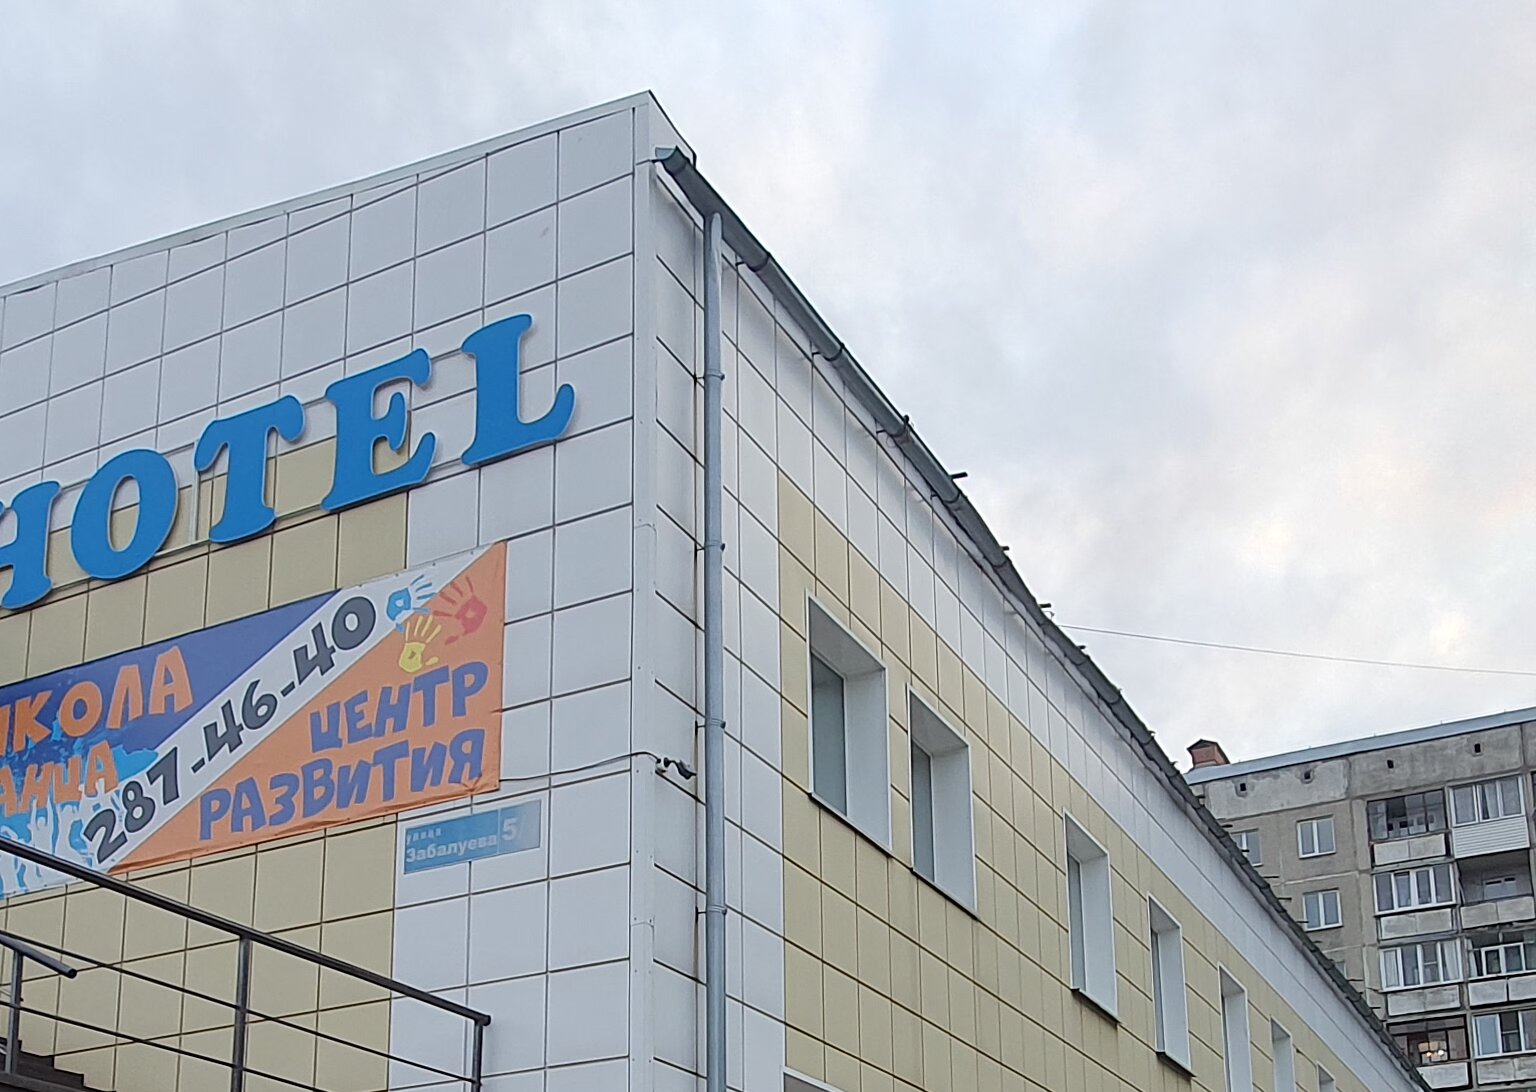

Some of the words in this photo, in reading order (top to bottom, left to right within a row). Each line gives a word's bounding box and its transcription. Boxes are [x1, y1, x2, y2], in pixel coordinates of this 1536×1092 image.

[83, 596, 376, 865] 287-46-40
[310, 661, 489, 753] ЦЕНТР
[199, 728, 485, 841] РАЗВИТИЯ
[405, 833, 498, 863] Забалуева
